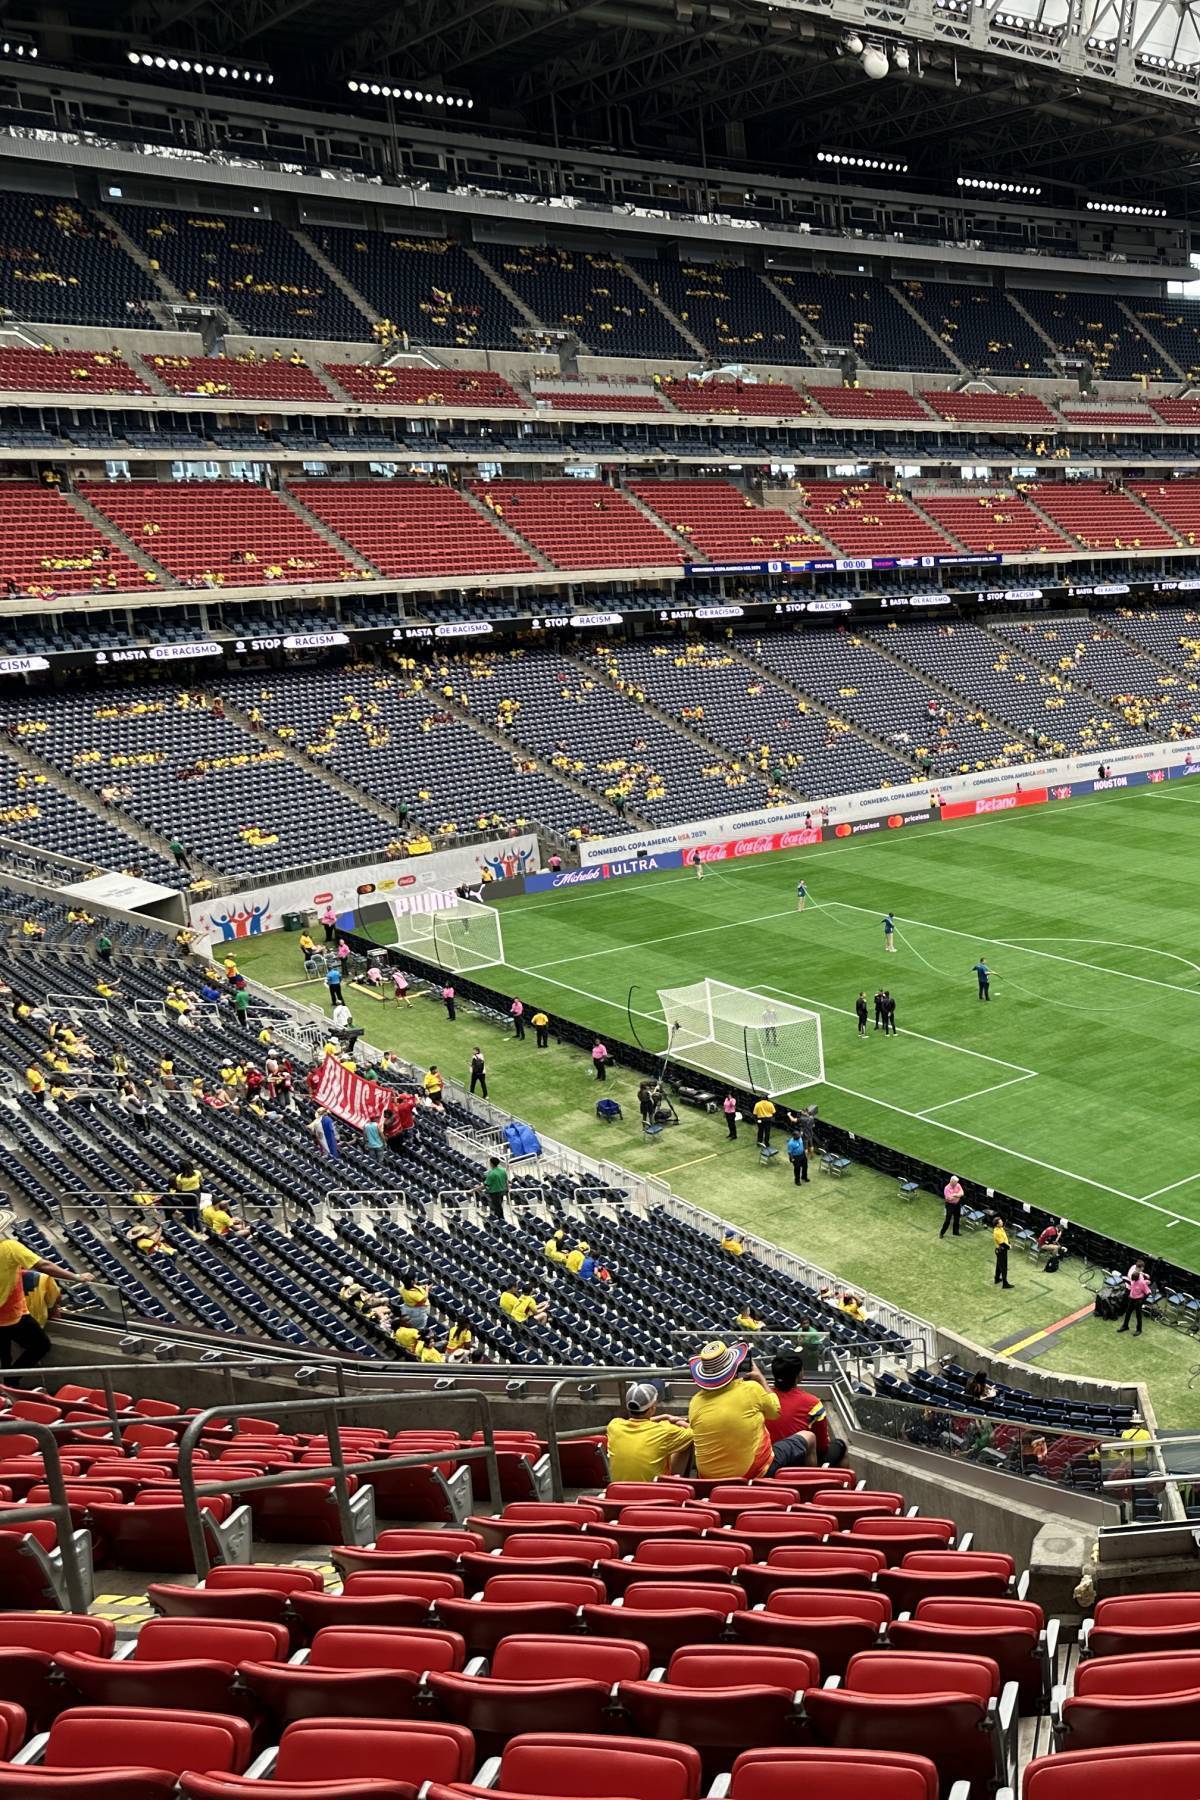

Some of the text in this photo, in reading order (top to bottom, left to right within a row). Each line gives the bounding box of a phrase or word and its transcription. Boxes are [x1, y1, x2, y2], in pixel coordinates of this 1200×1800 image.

[671, 611, 693, 619] BASTA
[709, 607, 740, 616] RACISMO
[786, 602, 842, 612] STOP RACISM
[545, 616, 611, 628] STOP RACISM
[405, 624, 488, 637] BASTA DE RACISMO
[251, 635, 335, 650] STOP RACISM
[113, 645, 217, 662] BASTA DE RACISMO
[973, 777, 1000, 786] CONMEBOL
[1015, 770, 1036, 779] AMERICA
[1094, 776, 1127, 791] HOUSTON
[860, 796, 890, 807] CONMEBOL
[906, 789, 929, 798] AMERICA
[733, 818, 767, 830] CONMEBOL
[767, 814, 784, 823] COPA
[904, 813, 930, 824] priceless
[852, 822, 880, 834] priceless
[588, 845, 626, 858] CONMEBOL
[627, 841, 646, 850] COPA
[647, 835, 677, 847] AMERICA
[677, 832, 691, 841] USA
[780, 827, 818, 848] Coca-Cola
[734, 836, 774, 856] Coca-Cola
[552, 858, 658, 888] Michelob ULTRA
